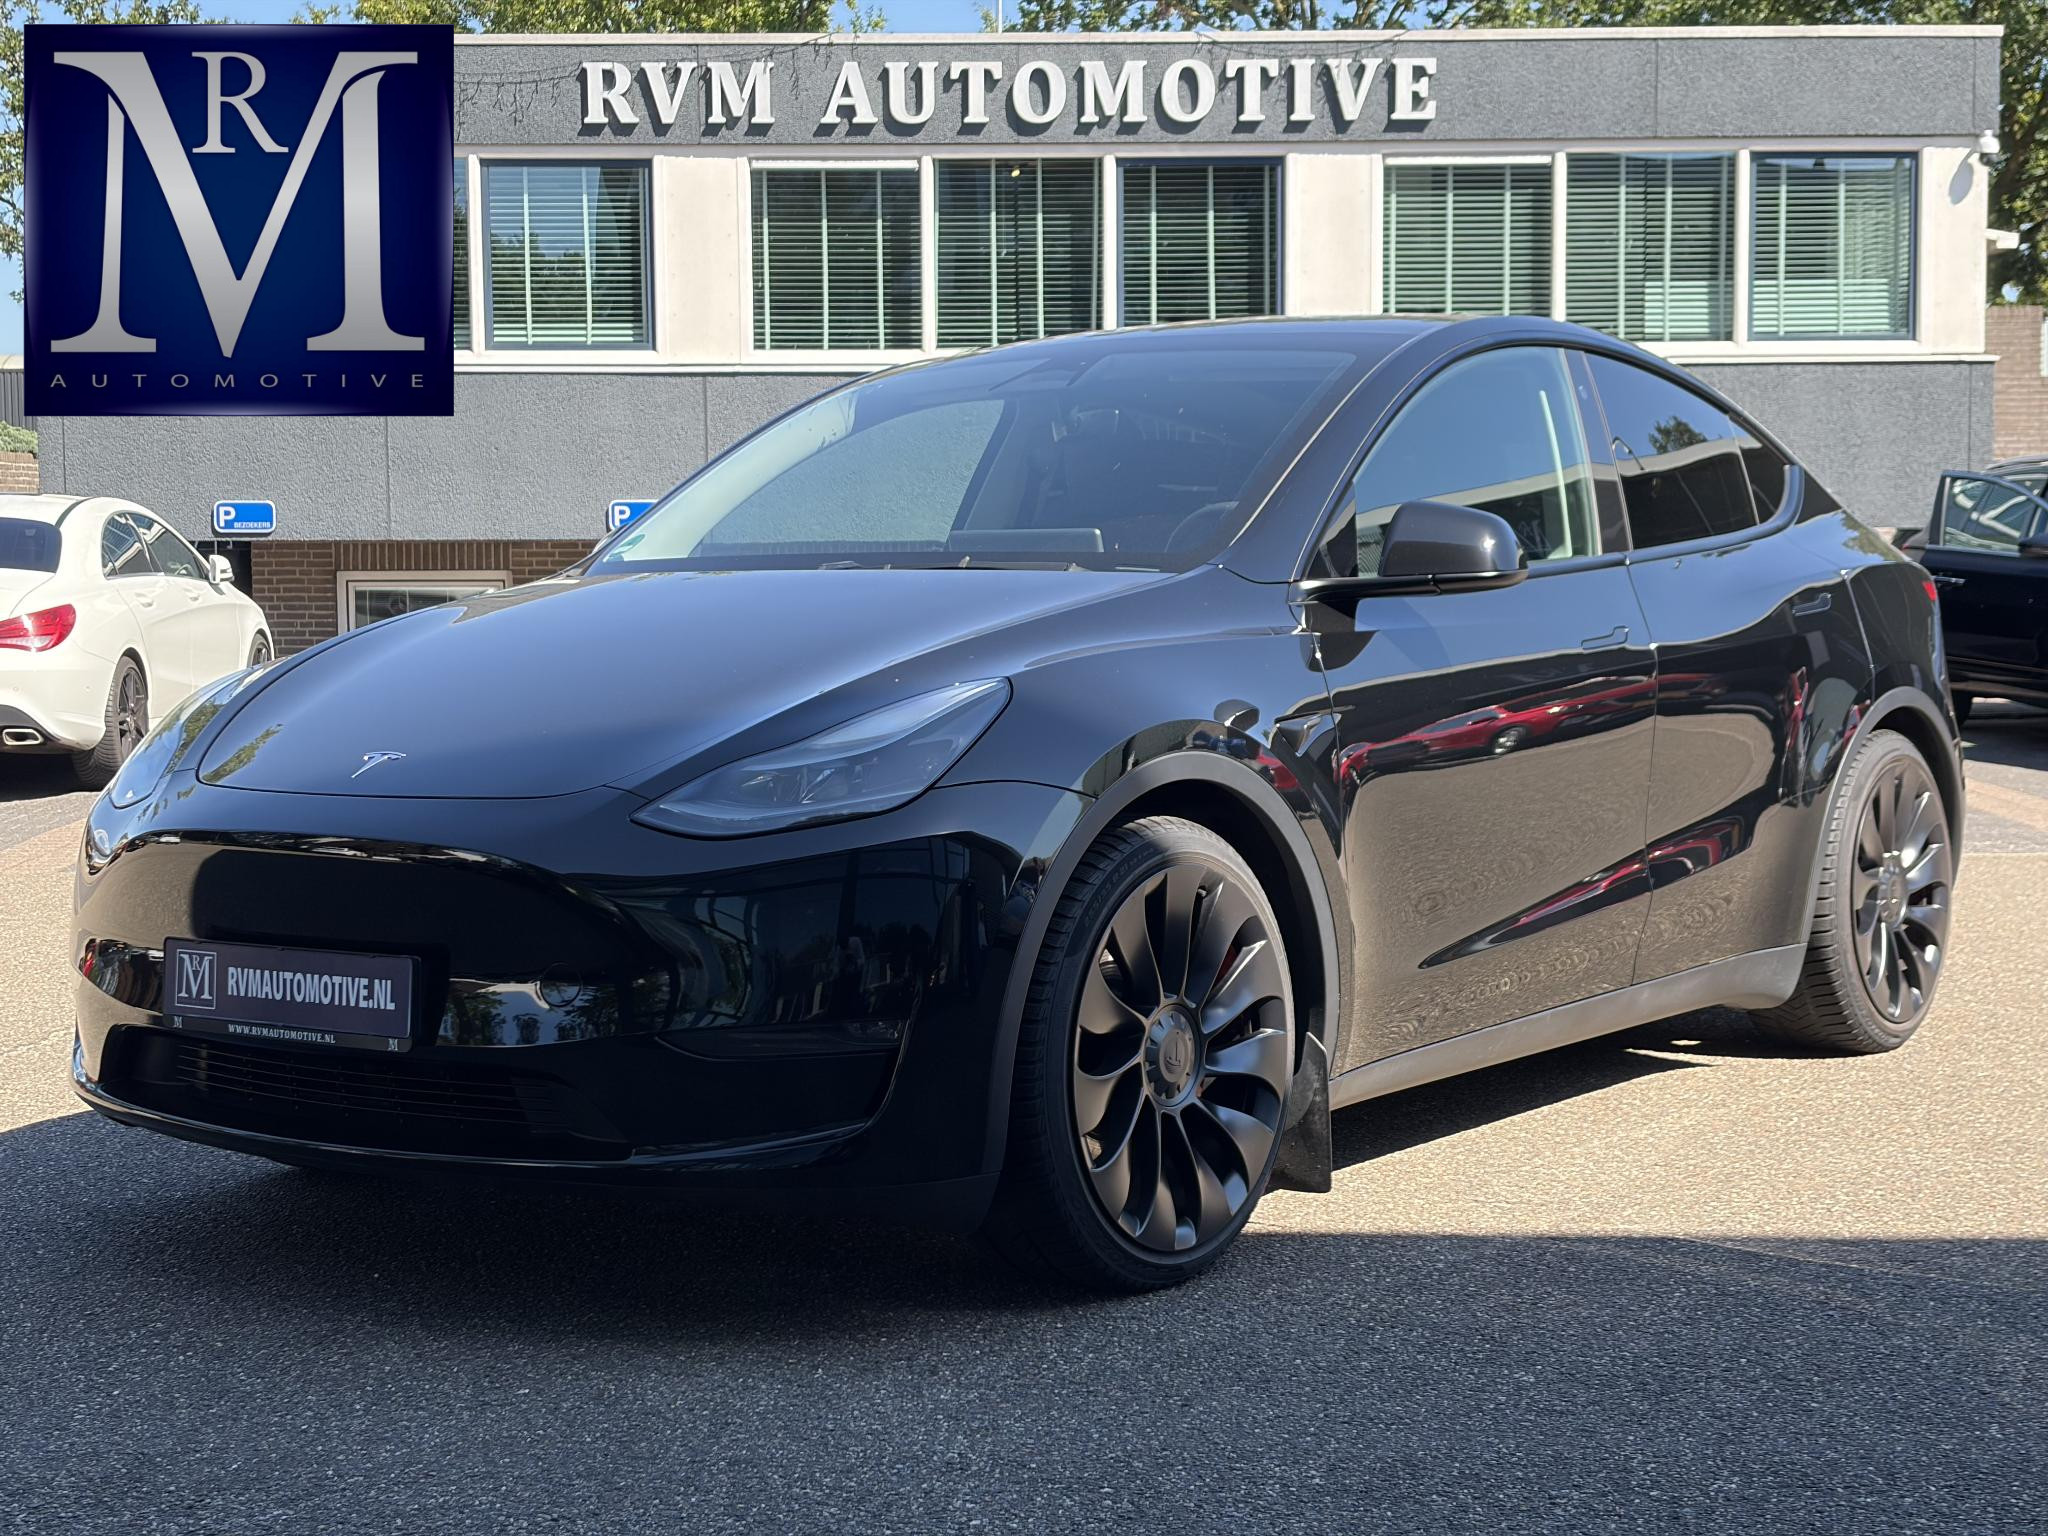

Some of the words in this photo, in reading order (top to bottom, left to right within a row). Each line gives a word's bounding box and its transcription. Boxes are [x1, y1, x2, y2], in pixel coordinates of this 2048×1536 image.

[581, 60, 775, 125] RVM
[820, 56, 1438, 125] AUTOMOTIVE
[219, 506, 236, 527] P
[614, 505, 631, 527] P
[228, 967, 395, 1010] RVMAUTOMOTIVE.NL
[228, 1024, 336, 1044] WWW.RVMAUTOMOTIVE.NL
